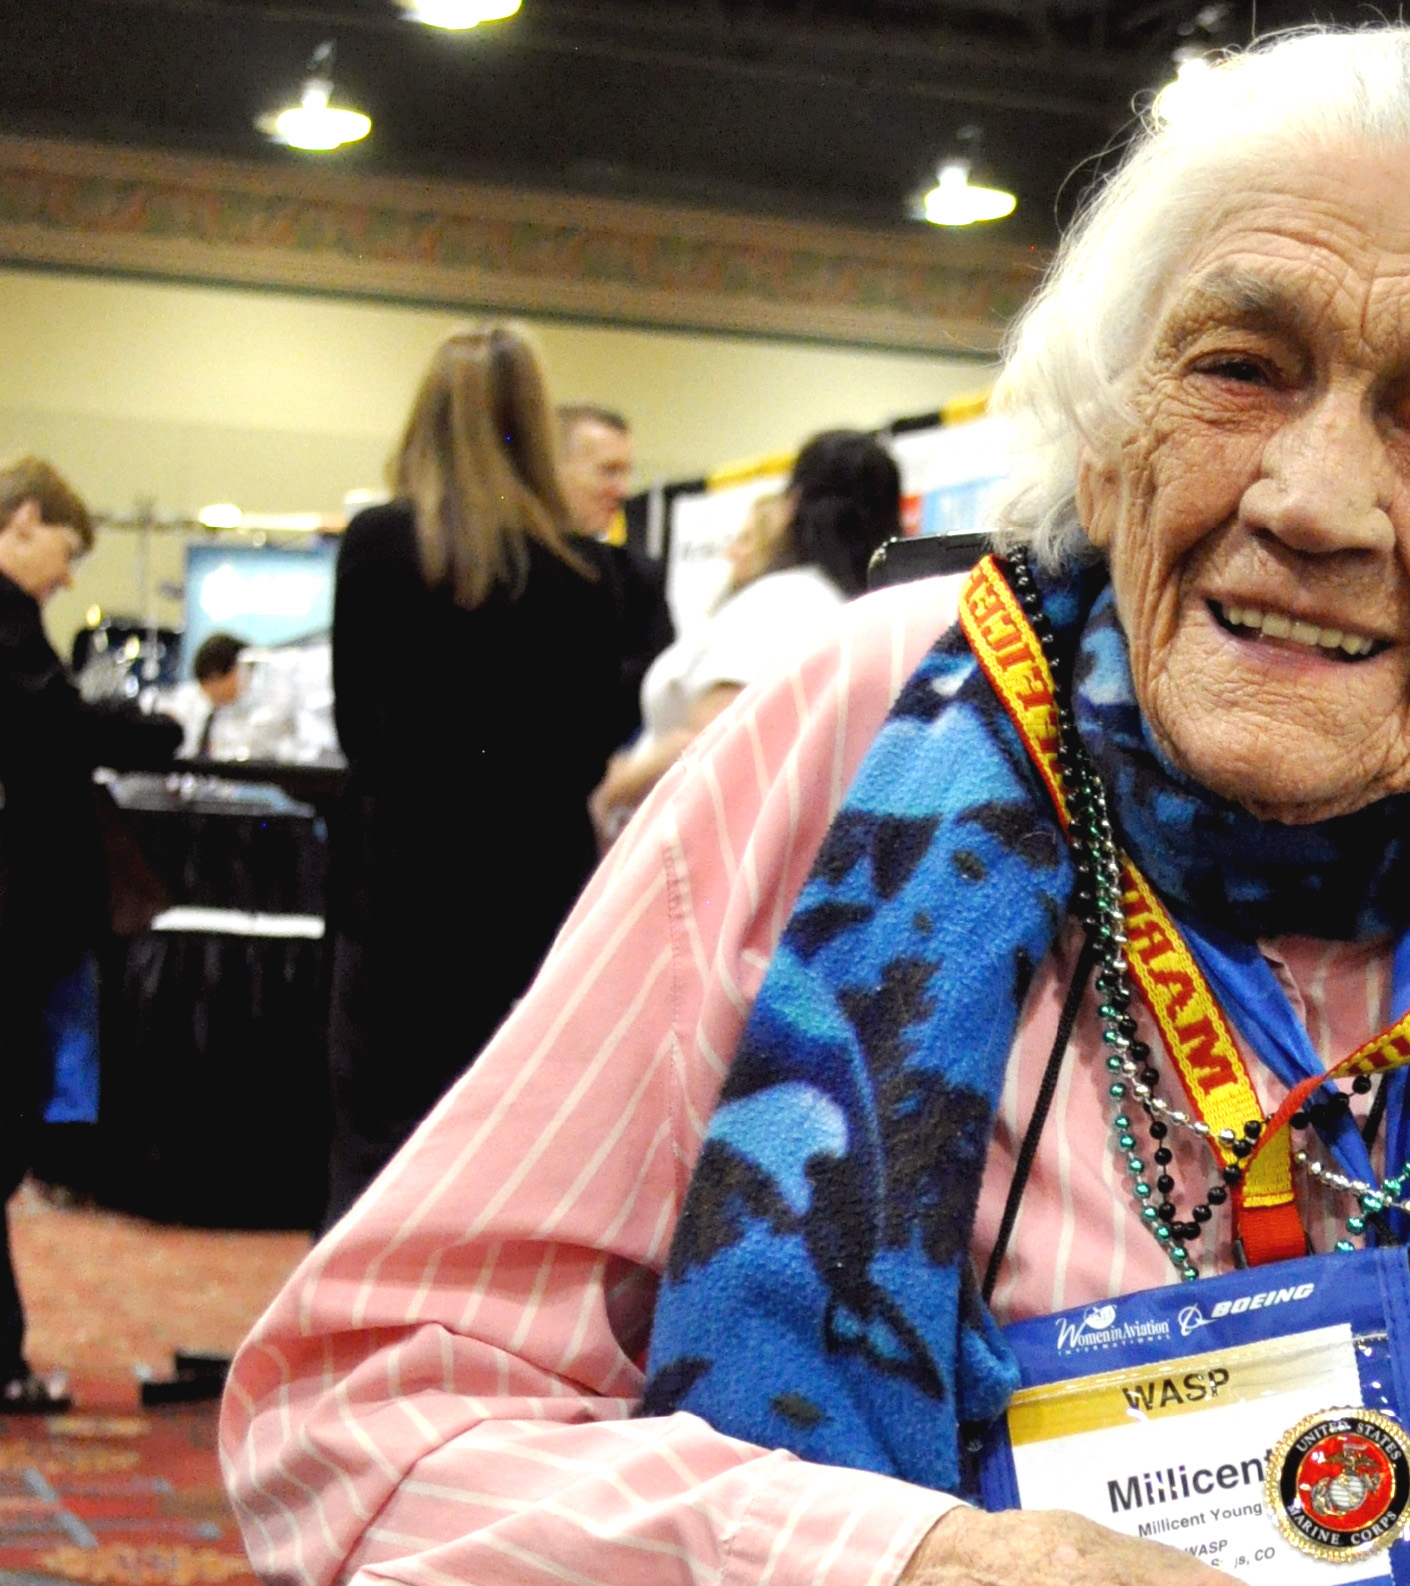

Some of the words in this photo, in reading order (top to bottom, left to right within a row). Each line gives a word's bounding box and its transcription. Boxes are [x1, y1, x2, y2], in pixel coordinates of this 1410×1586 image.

[1211, 1283, 1315, 1318] BOEING
[1122, 1368, 1230, 1411] WASP
[1356, 1421, 1402, 1461] STATES
[1138, 1512, 1206, 1537] Millicent
[1210, 1502, 1262, 1522] Young
[1287, 1505, 1341, 1546] MARINE
[1350, 1511, 1397, 1545] CORPS
[1254, 1546, 1276, 1562] CO
